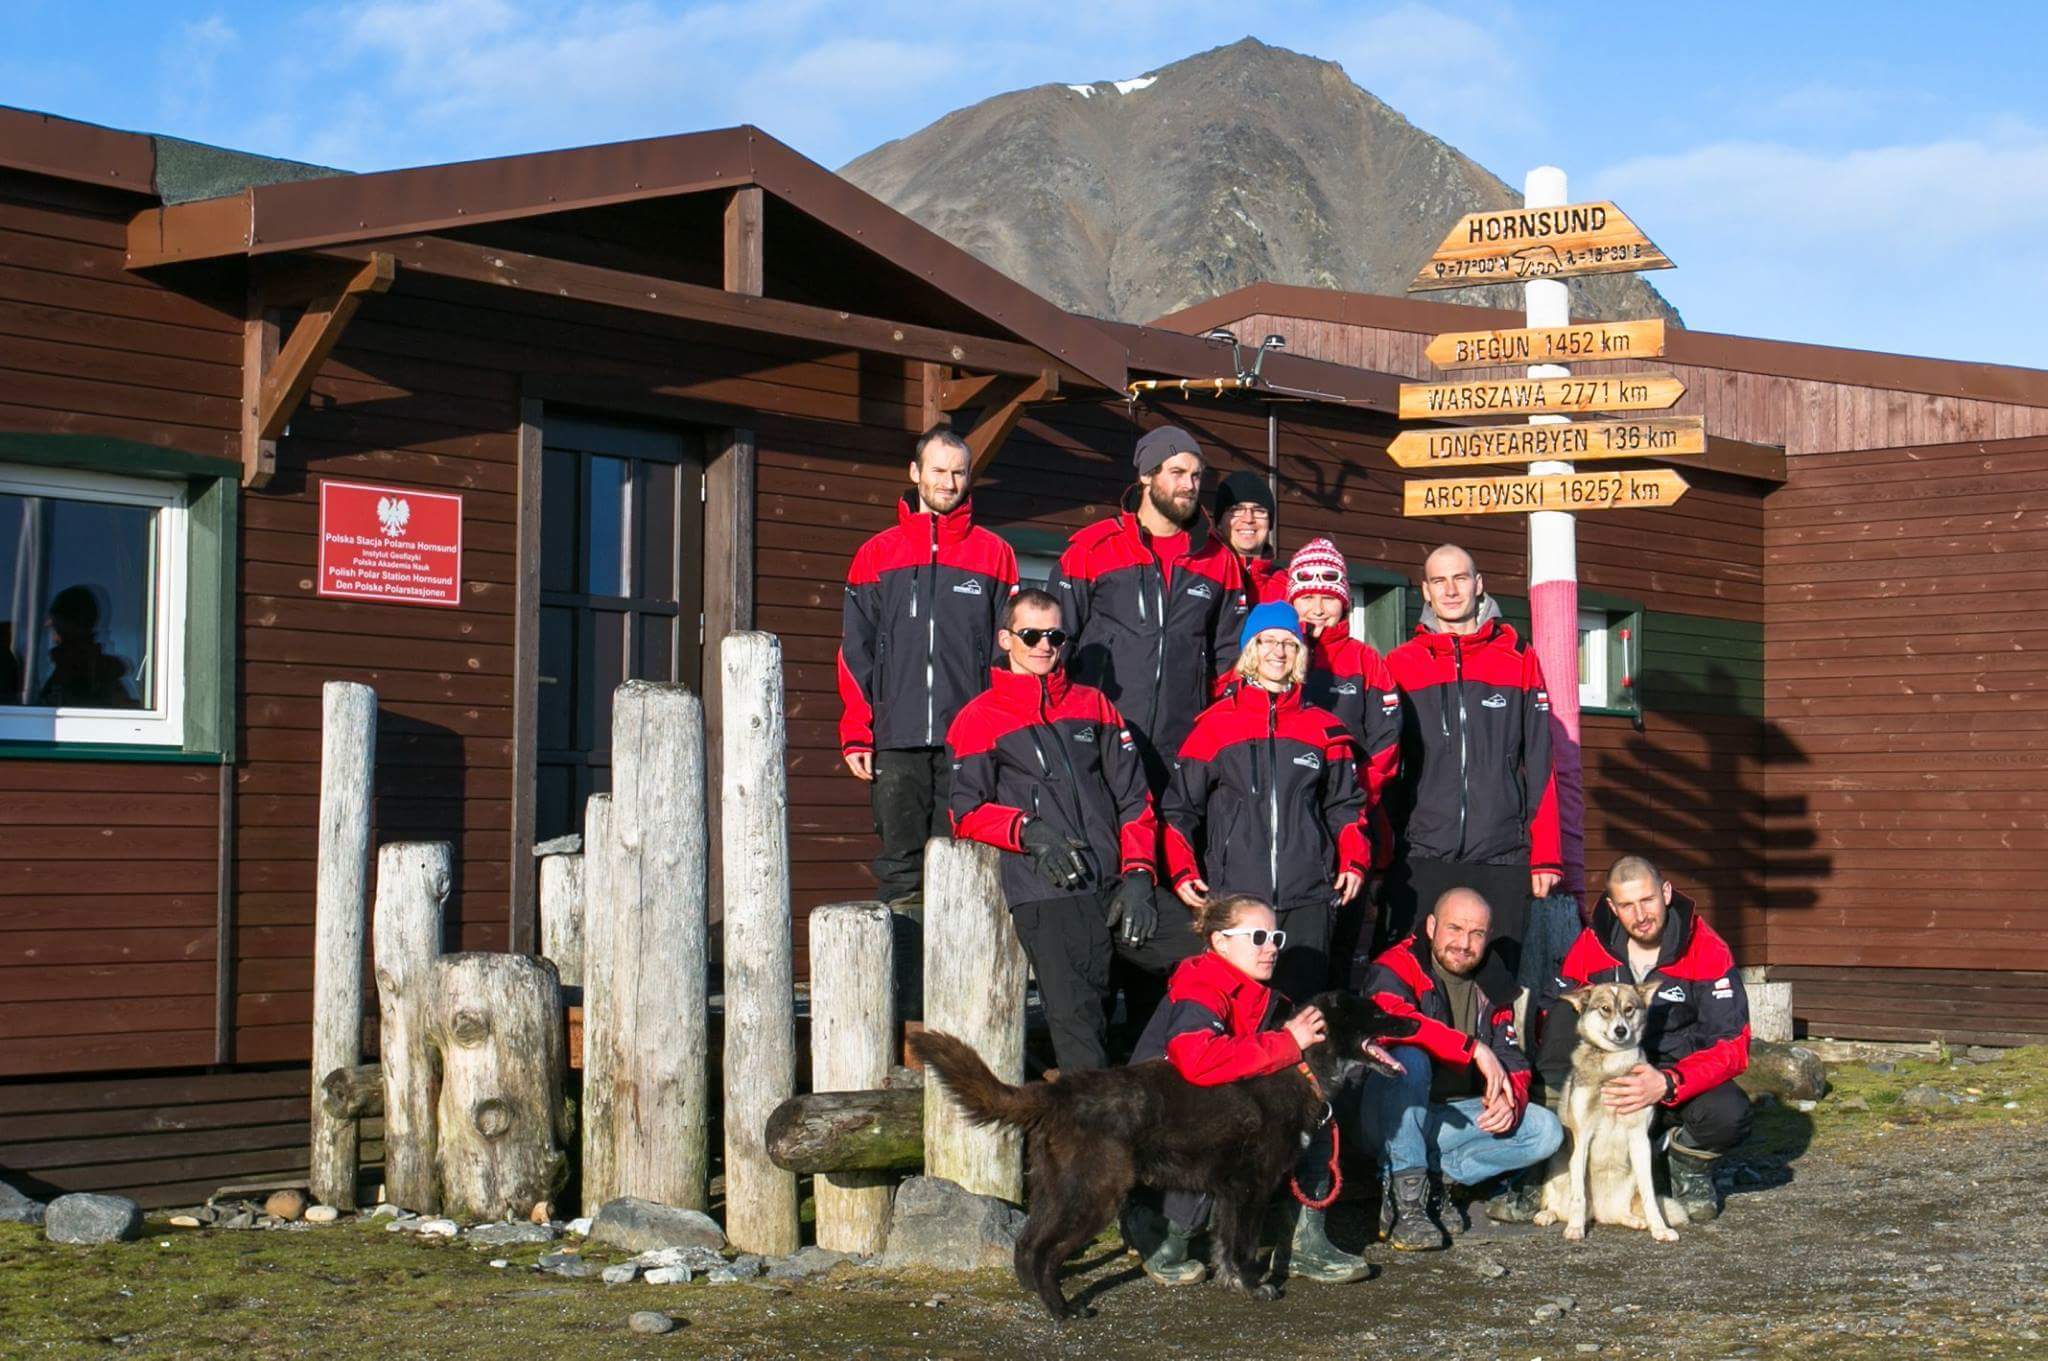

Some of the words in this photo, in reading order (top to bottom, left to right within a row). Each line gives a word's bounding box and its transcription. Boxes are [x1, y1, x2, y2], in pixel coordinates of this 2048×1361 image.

[1468, 207, 1606, 243] HORNSUND
[1456, 336, 1529, 362] BIEGUN
[1546, 331, 1593, 355] 1452
[1602, 330, 1630, 352] km
[1428, 385, 1546, 410] WARSZAWA
[1561, 382, 1608, 405] 2771
[1619, 381, 1648, 402] km
[1430, 429, 1588, 459] LONGYEARBYEN
[1605, 427, 1639, 450] 136
[1648, 427, 1677, 448] km
[1424, 481, 1544, 508] ARCTOWSKI
[1560, 479, 1622, 503] 16252
[1630, 478, 1659, 500] km
[326, 533, 354, 544] Polska
[357, 536, 382, 546] Stacja
[384, 539, 415, 549] Polarna
[418, 542, 457, 553] Hornsund
[329, 567, 355, 577] Polish
[358, 570, 379, 579] Polar
[382, 571, 411, 581] Station
[413, 574, 452, 585] Hornsund
[353, 558, 376, 567] Polska
[336, 580, 352, 589] Den
[355, 582, 383, 592] Polske
[385, 584, 445, 597] Polarstasjonen
